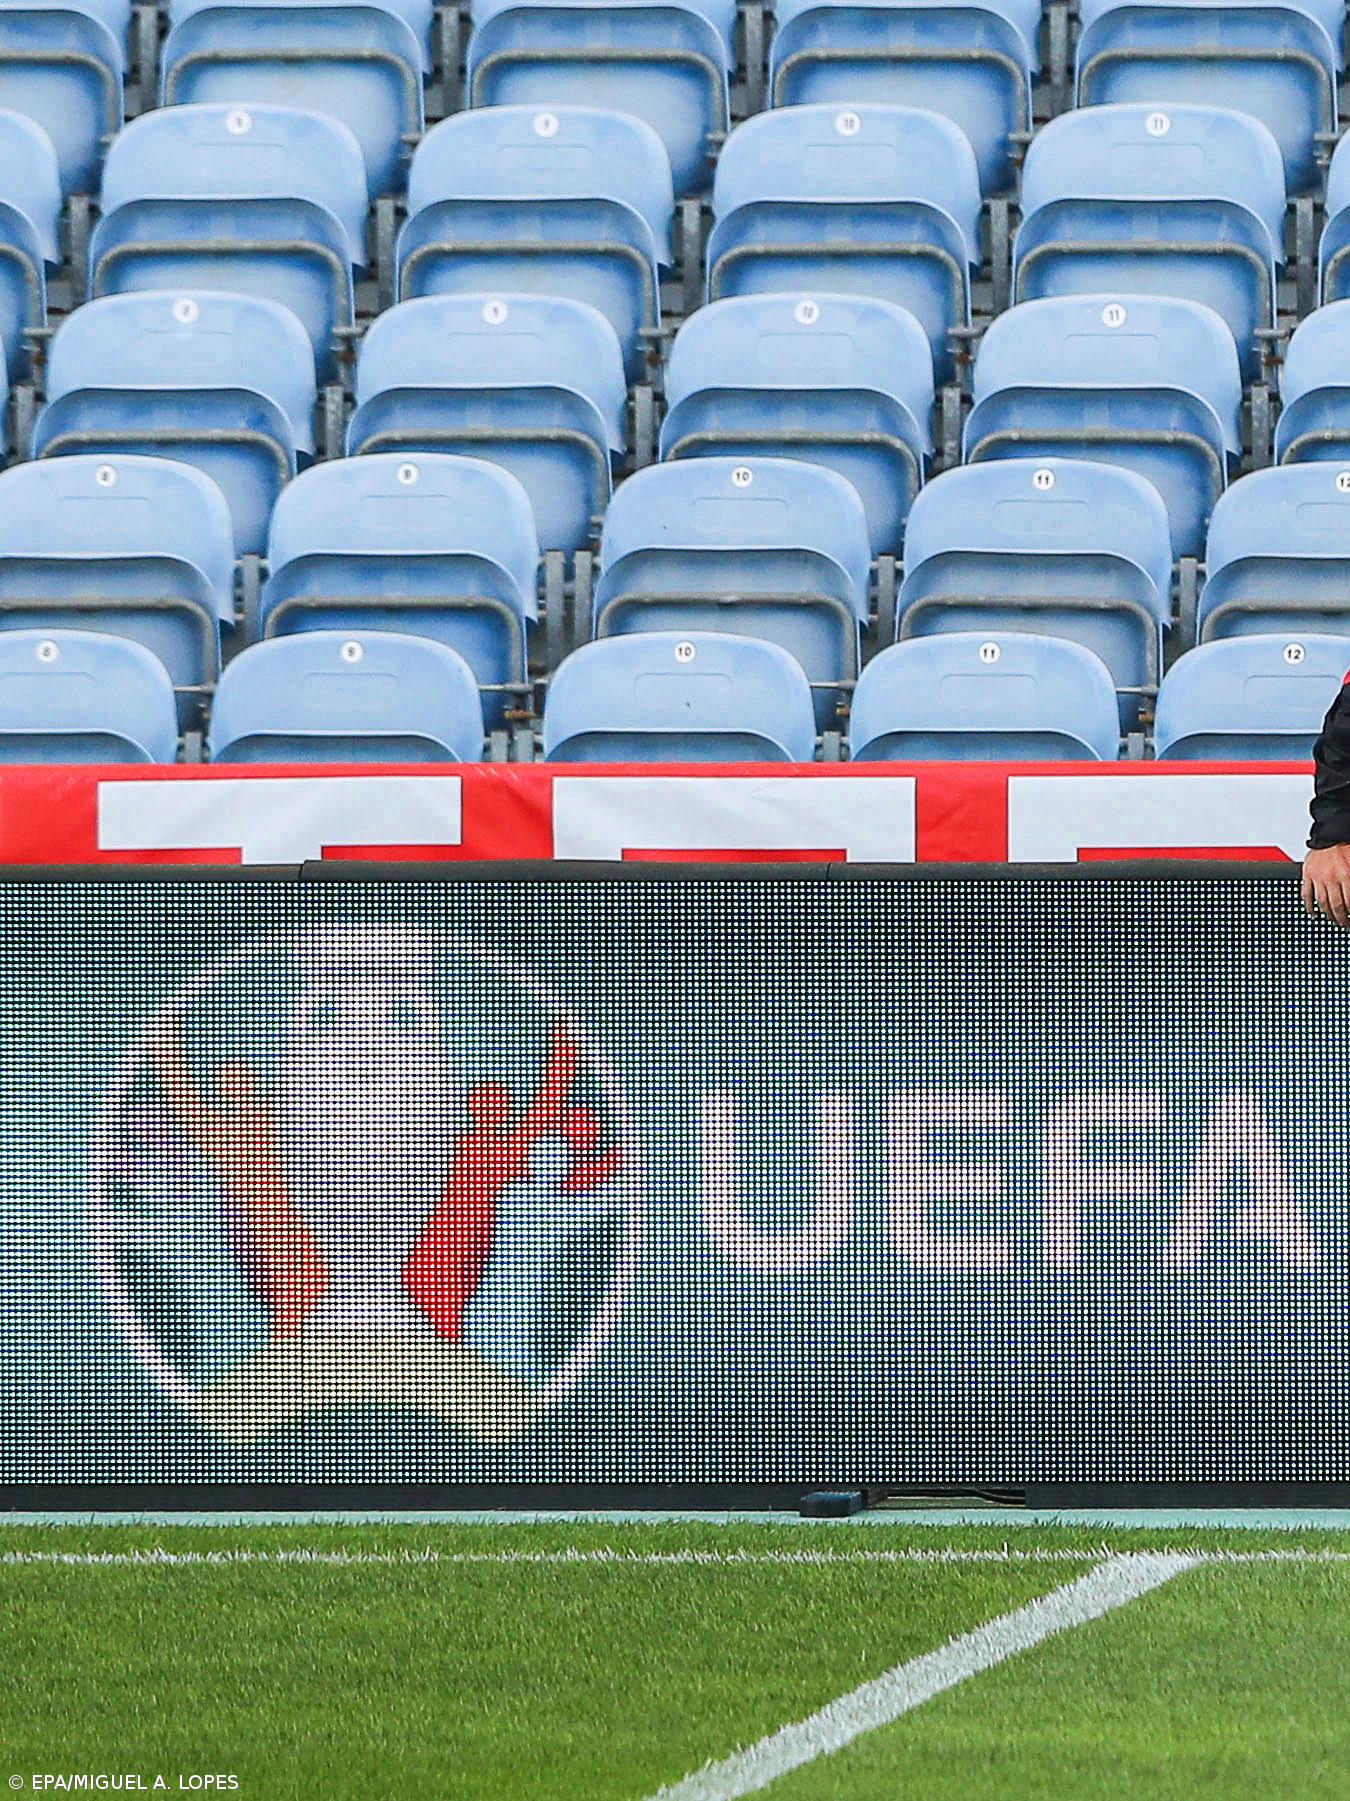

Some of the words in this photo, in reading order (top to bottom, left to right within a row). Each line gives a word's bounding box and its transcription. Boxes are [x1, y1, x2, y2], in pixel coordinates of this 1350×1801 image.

[737, 471, 749, 482] 10
[1038, 475, 1049, 485] 11
[679, 646, 692, 657] 10
[984, 648, 995, 658] 11
[1288, 648, 1301, 659] 12
[701, 1090, 1323, 1270] UEFA
